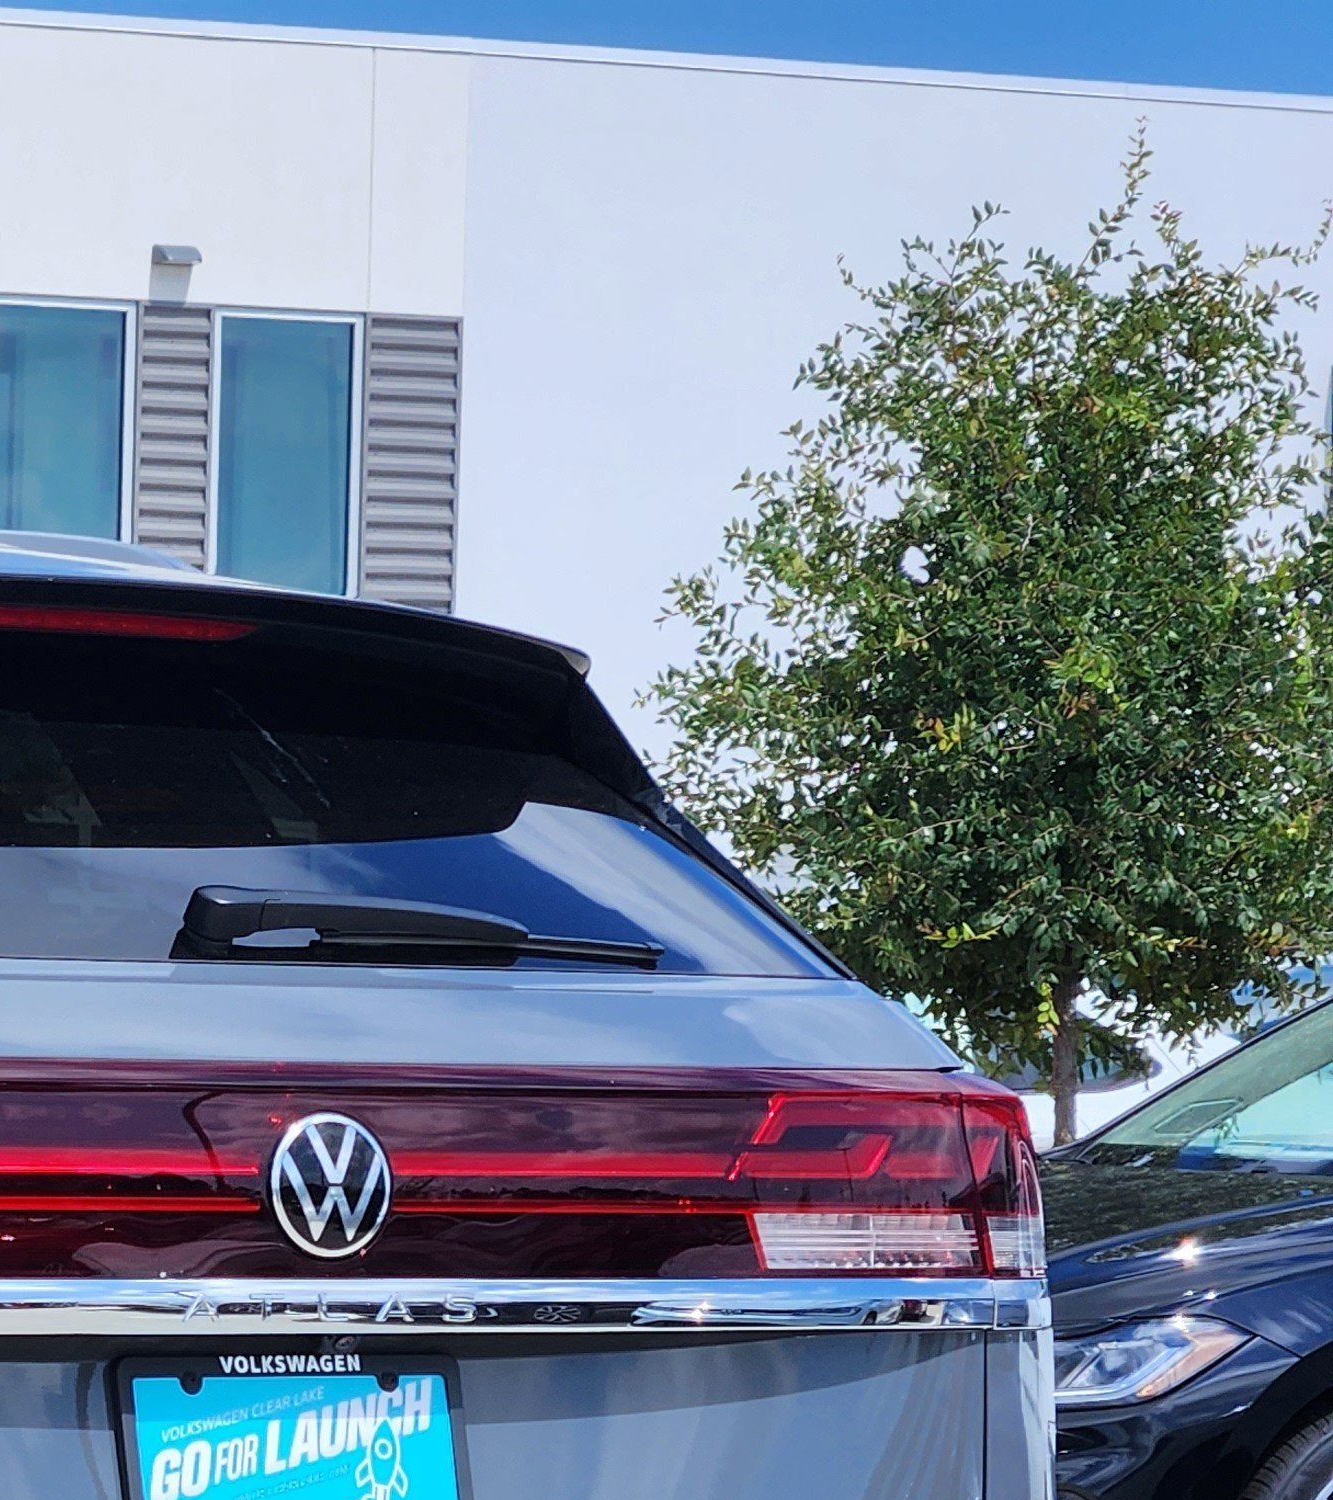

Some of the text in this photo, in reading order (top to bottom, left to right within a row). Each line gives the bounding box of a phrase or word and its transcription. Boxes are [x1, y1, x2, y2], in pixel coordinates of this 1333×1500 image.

[181, 1292, 479, 1324] ATLAS
[219, 1354, 362, 1374] VOLKSWAGEN
[161, 1385, 326, 1443] VOLKSWAGEN CLEAR LAKE
[214, 1433, 259, 1486] FOR
[264, 1378, 433, 1475] LAUNCH
